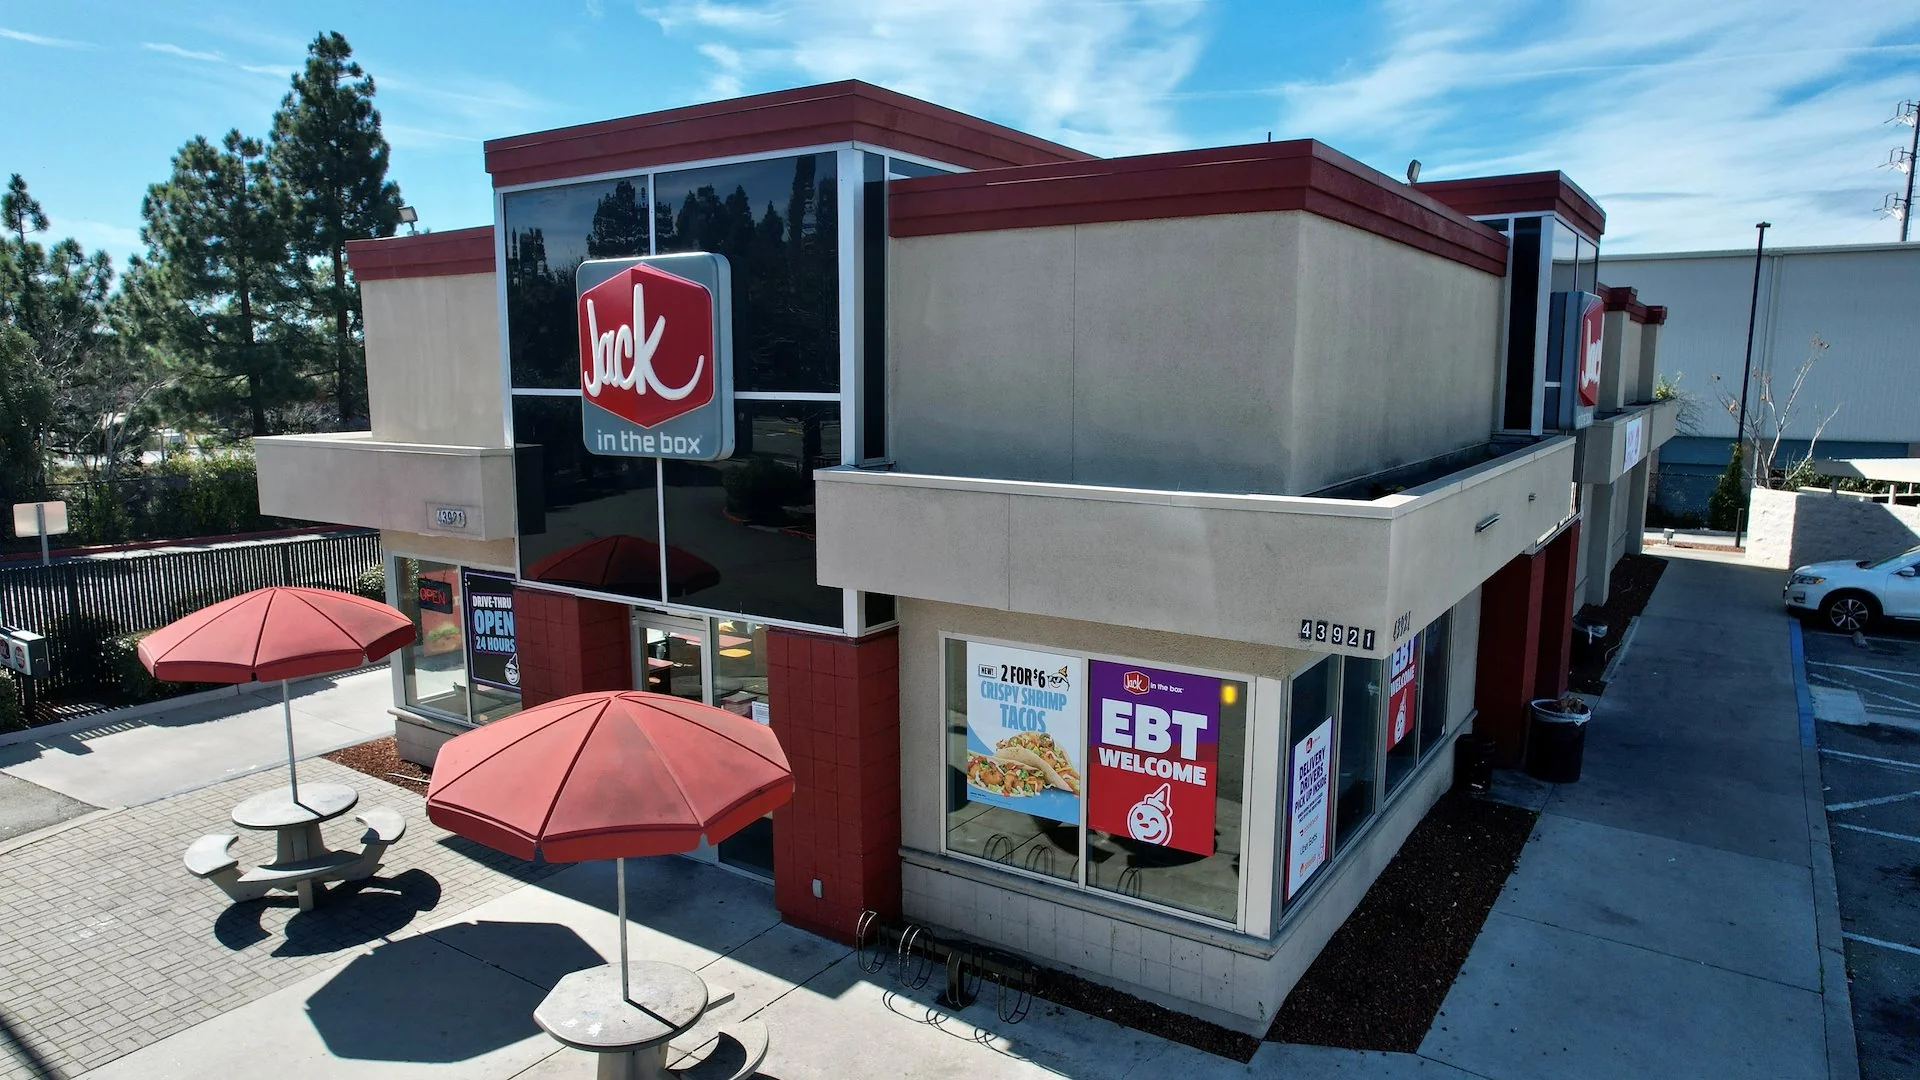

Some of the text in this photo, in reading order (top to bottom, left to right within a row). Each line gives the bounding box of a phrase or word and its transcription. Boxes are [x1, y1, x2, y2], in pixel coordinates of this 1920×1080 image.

[584, 282, 705, 401] Jack
[597, 429, 701, 454] in the box
[420, 587, 446, 605] OPEN
[472, 595, 512, 609] DRIVE-THRU
[474, 609, 515, 636] OPEN
[1301, 621, 1373, 649] 43921
[476, 635, 515, 653] 24 HOURS
[981, 664, 1046, 689] NEW! 2 FOR $6
[1125, 674, 1183, 693] Jack in the box
[980, 680, 1068, 711] CRISPY SHRIMP
[1000, 703, 1047, 733] TACOS
[1101, 697, 1208, 761] EBT
[1099, 747, 1207, 786] WELCOME
[1299, 745, 1326, 780] DELIVERY
[1300, 762, 1323, 795] DRIVERS
[1294, 794, 1306, 813] PICK
[1313, 774, 1328, 796] INSIDE
